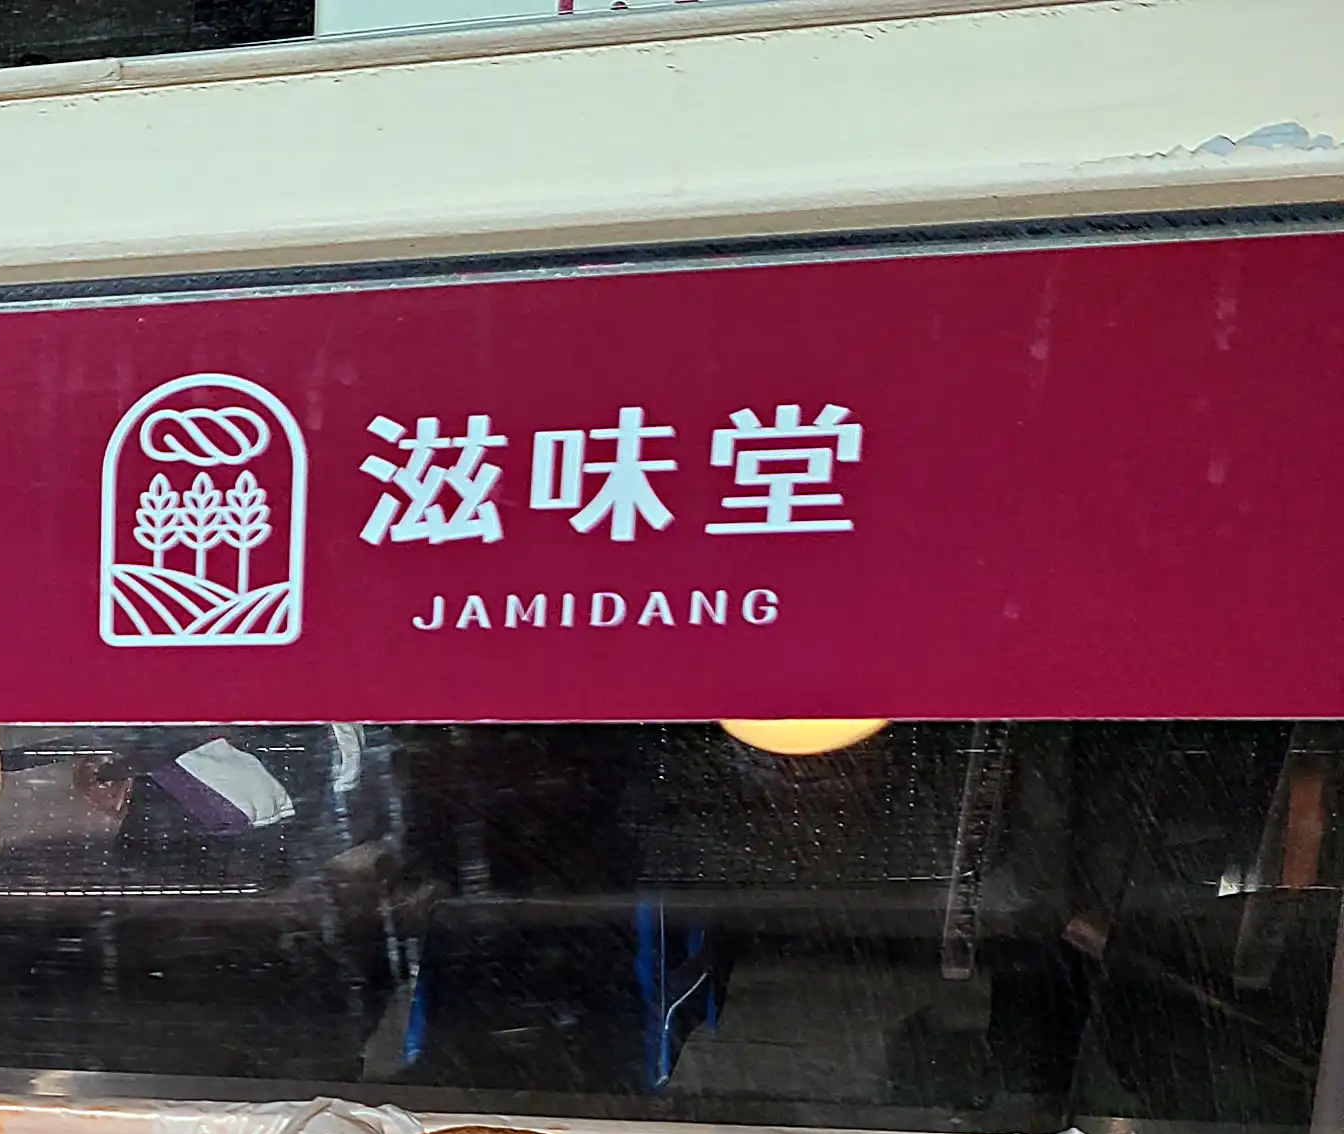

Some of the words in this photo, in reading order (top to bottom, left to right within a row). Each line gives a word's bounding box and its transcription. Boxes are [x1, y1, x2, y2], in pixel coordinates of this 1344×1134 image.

[359, 404, 863, 545] 滋味堂
[412, 589, 781, 630] JAMIDANG
